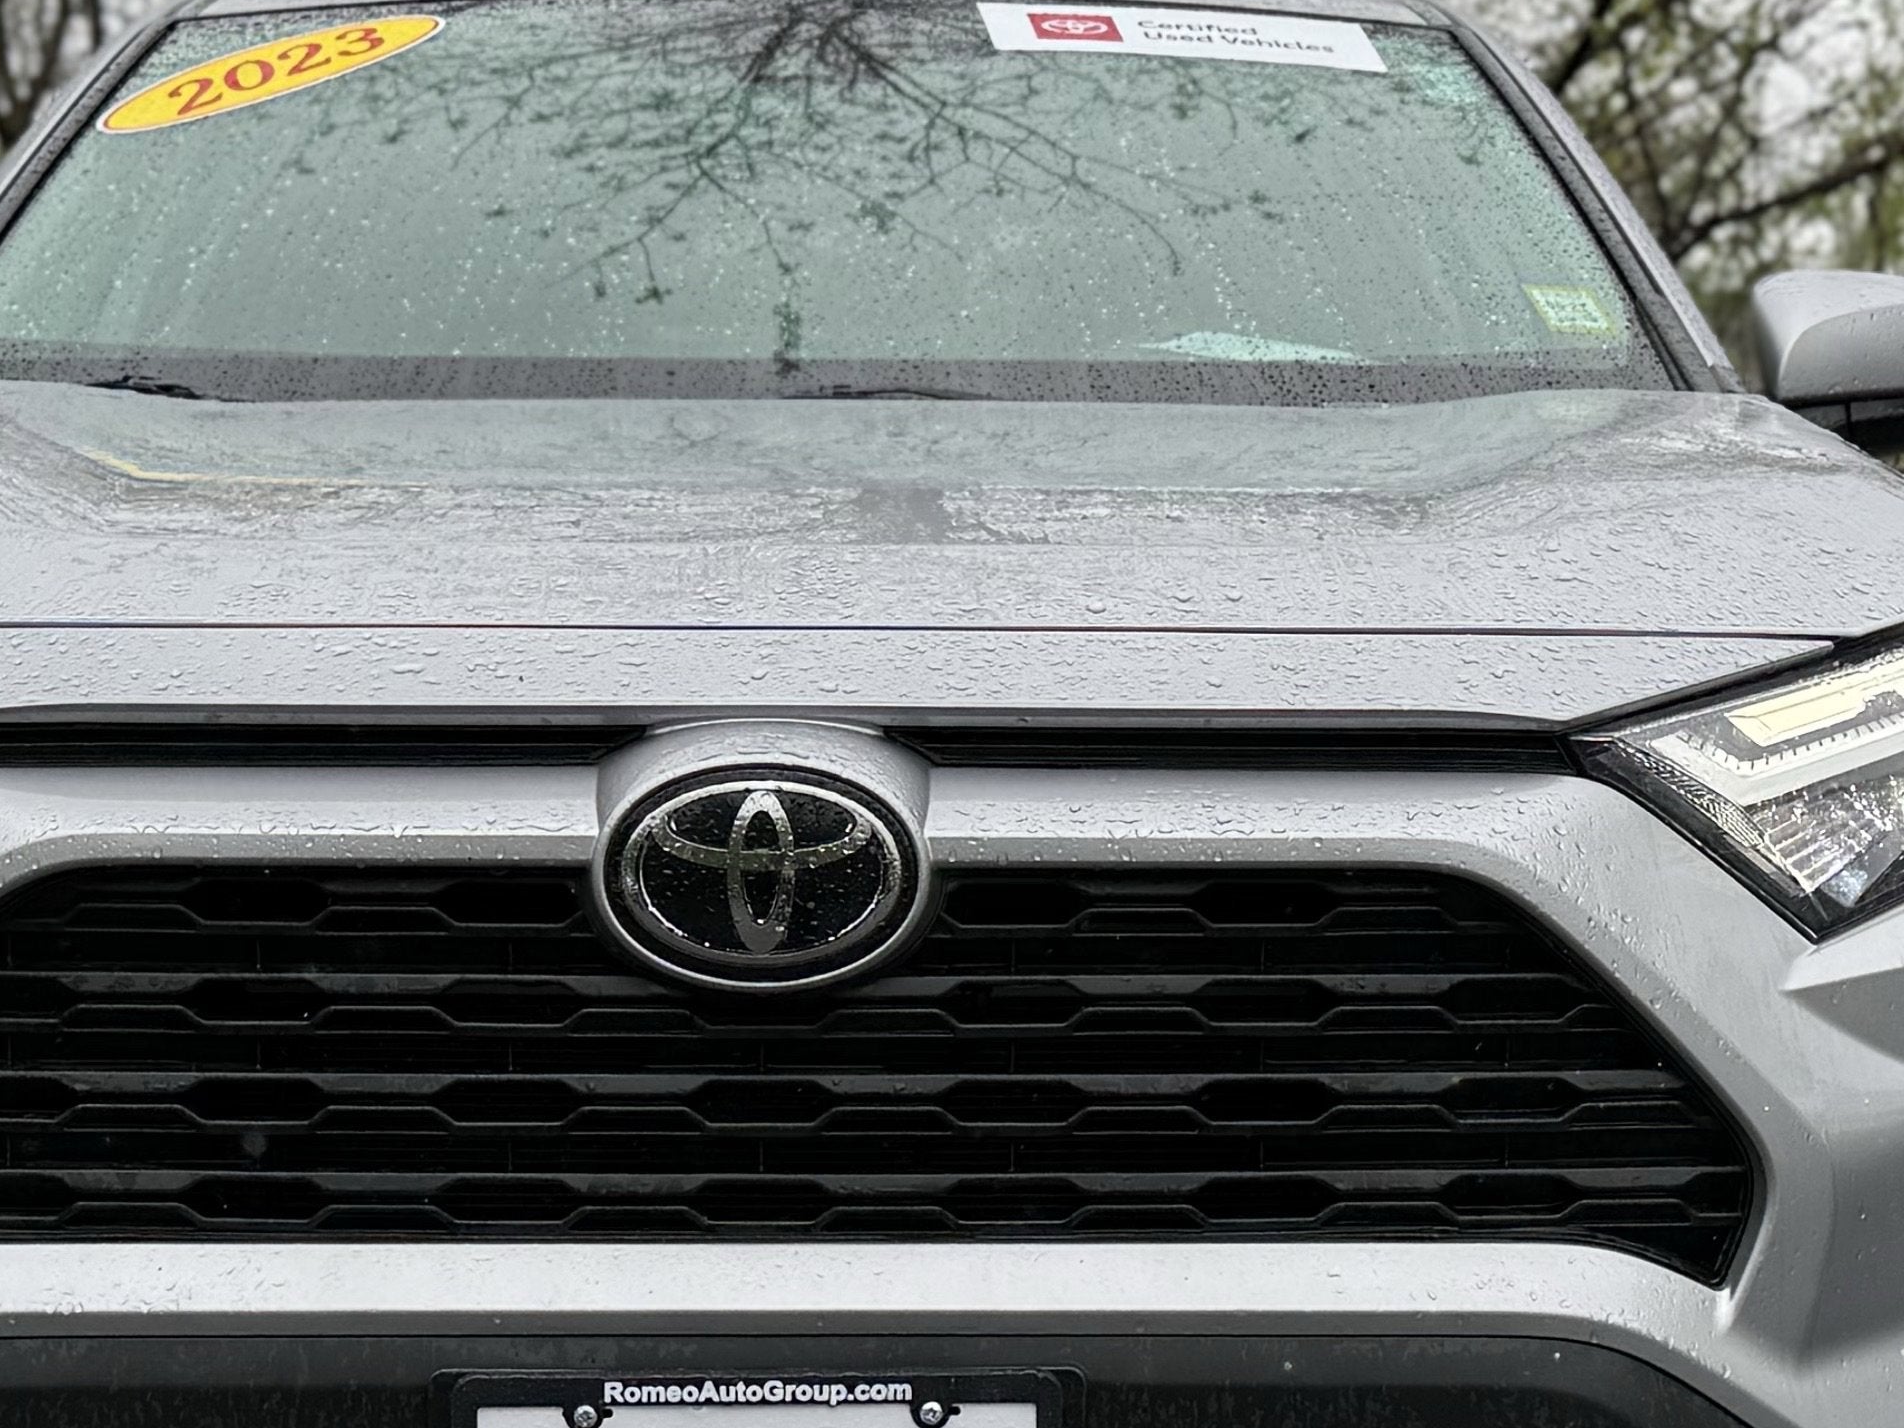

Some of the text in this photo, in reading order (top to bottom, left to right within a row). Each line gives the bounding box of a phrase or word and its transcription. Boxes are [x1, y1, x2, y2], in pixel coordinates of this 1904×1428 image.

[1138, 20, 1257, 34] Certified
[1143, 32, 1334, 53] Used Vehicles
[167, 27, 385, 116] 2023
[603, 1380, 913, 1404] RomeoAutoGroup.com
